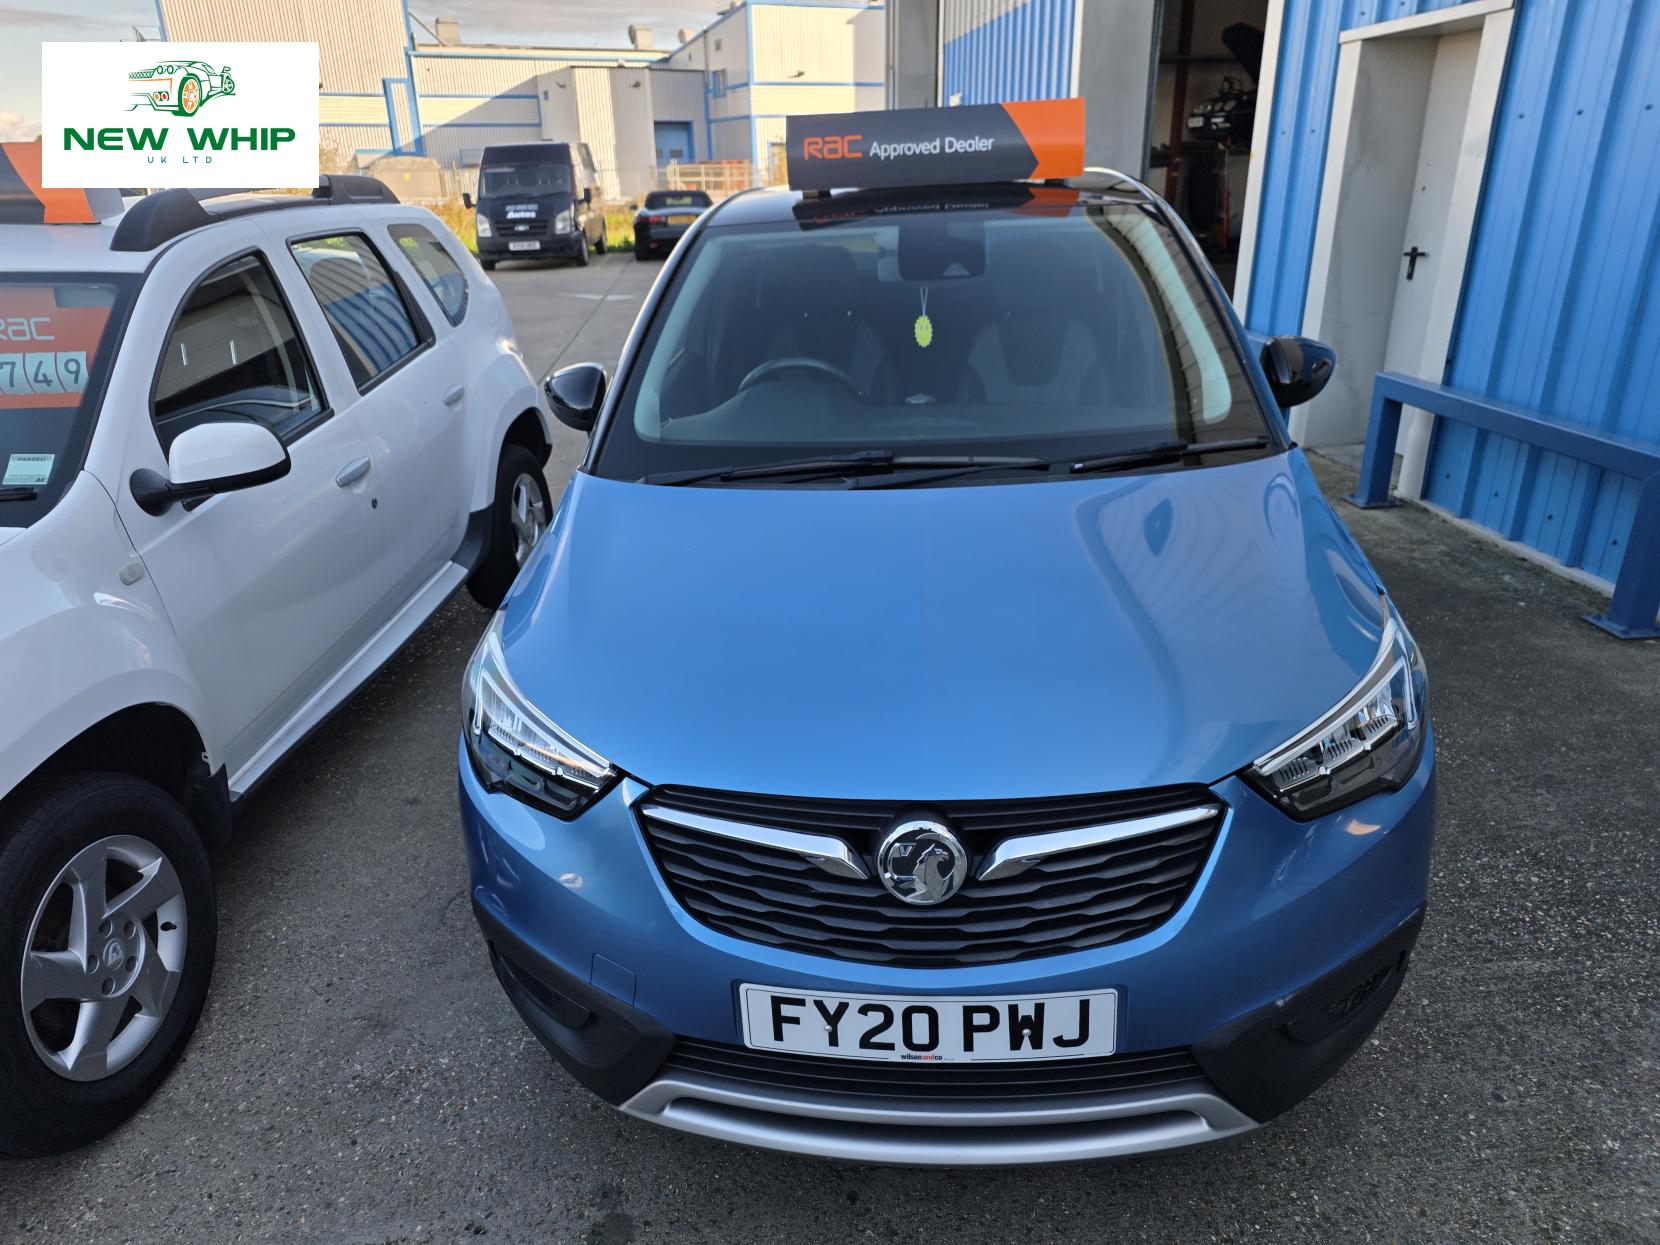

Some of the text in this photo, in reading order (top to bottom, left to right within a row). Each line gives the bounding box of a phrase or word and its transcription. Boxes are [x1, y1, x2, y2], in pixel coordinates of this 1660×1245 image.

[869, 137, 940, 161] Approved
[944, 135, 995, 154] Dealer
[770, 995, 1091, 1053] FY20 PWJ
